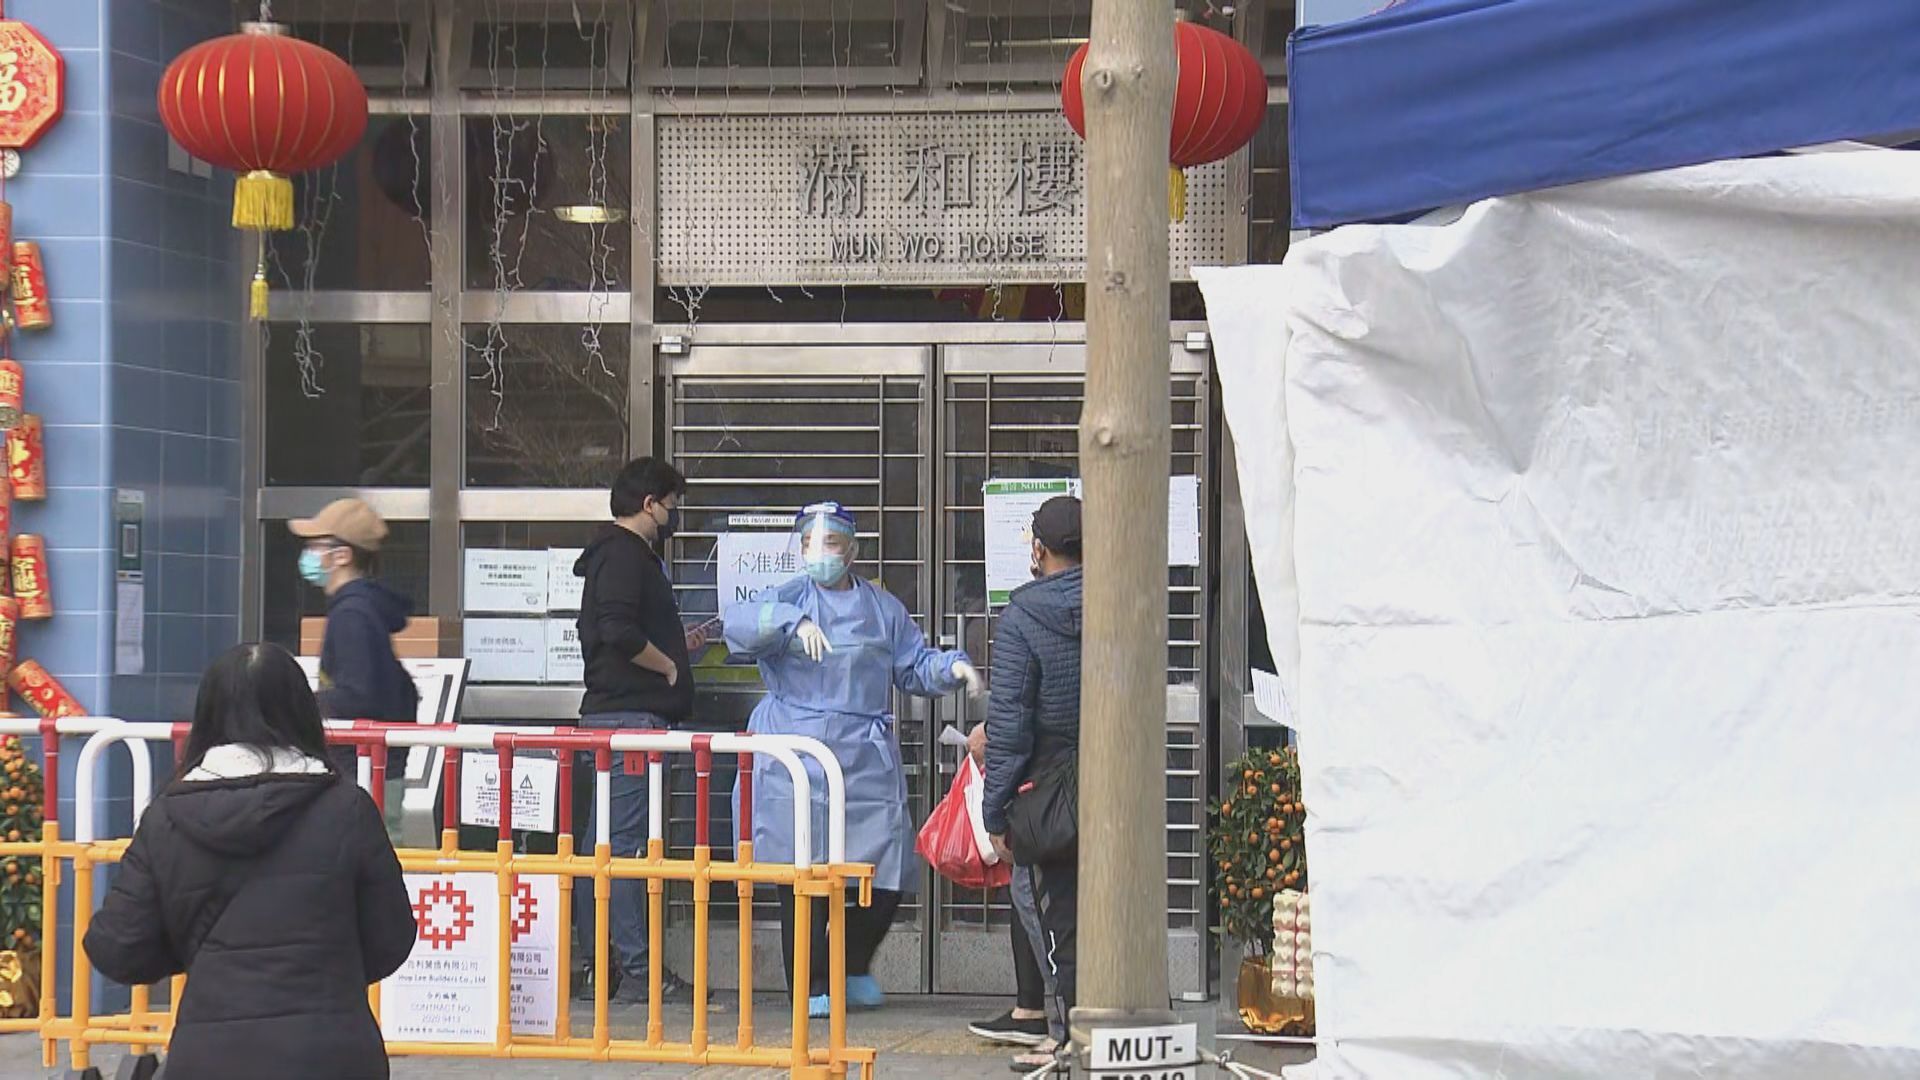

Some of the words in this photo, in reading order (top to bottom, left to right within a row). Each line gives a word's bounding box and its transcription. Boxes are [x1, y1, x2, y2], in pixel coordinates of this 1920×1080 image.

[800, 140, 1081, 218] 滿和樓
[830, 233, 883, 258] MUN
[900, 235, 941, 258] WO
[957, 232, 1048, 258] HOUSE
[1021, 481, 1054, 490] NOTICE
[731, 551, 806, 574] 不准進
[563, 629, 580, 642] 訪
[511, 952, 542, 963] 有限公司
[411, 1003, 455, 1012] CONTRACT
[1108, 1035, 1183, 1062] MUT-
